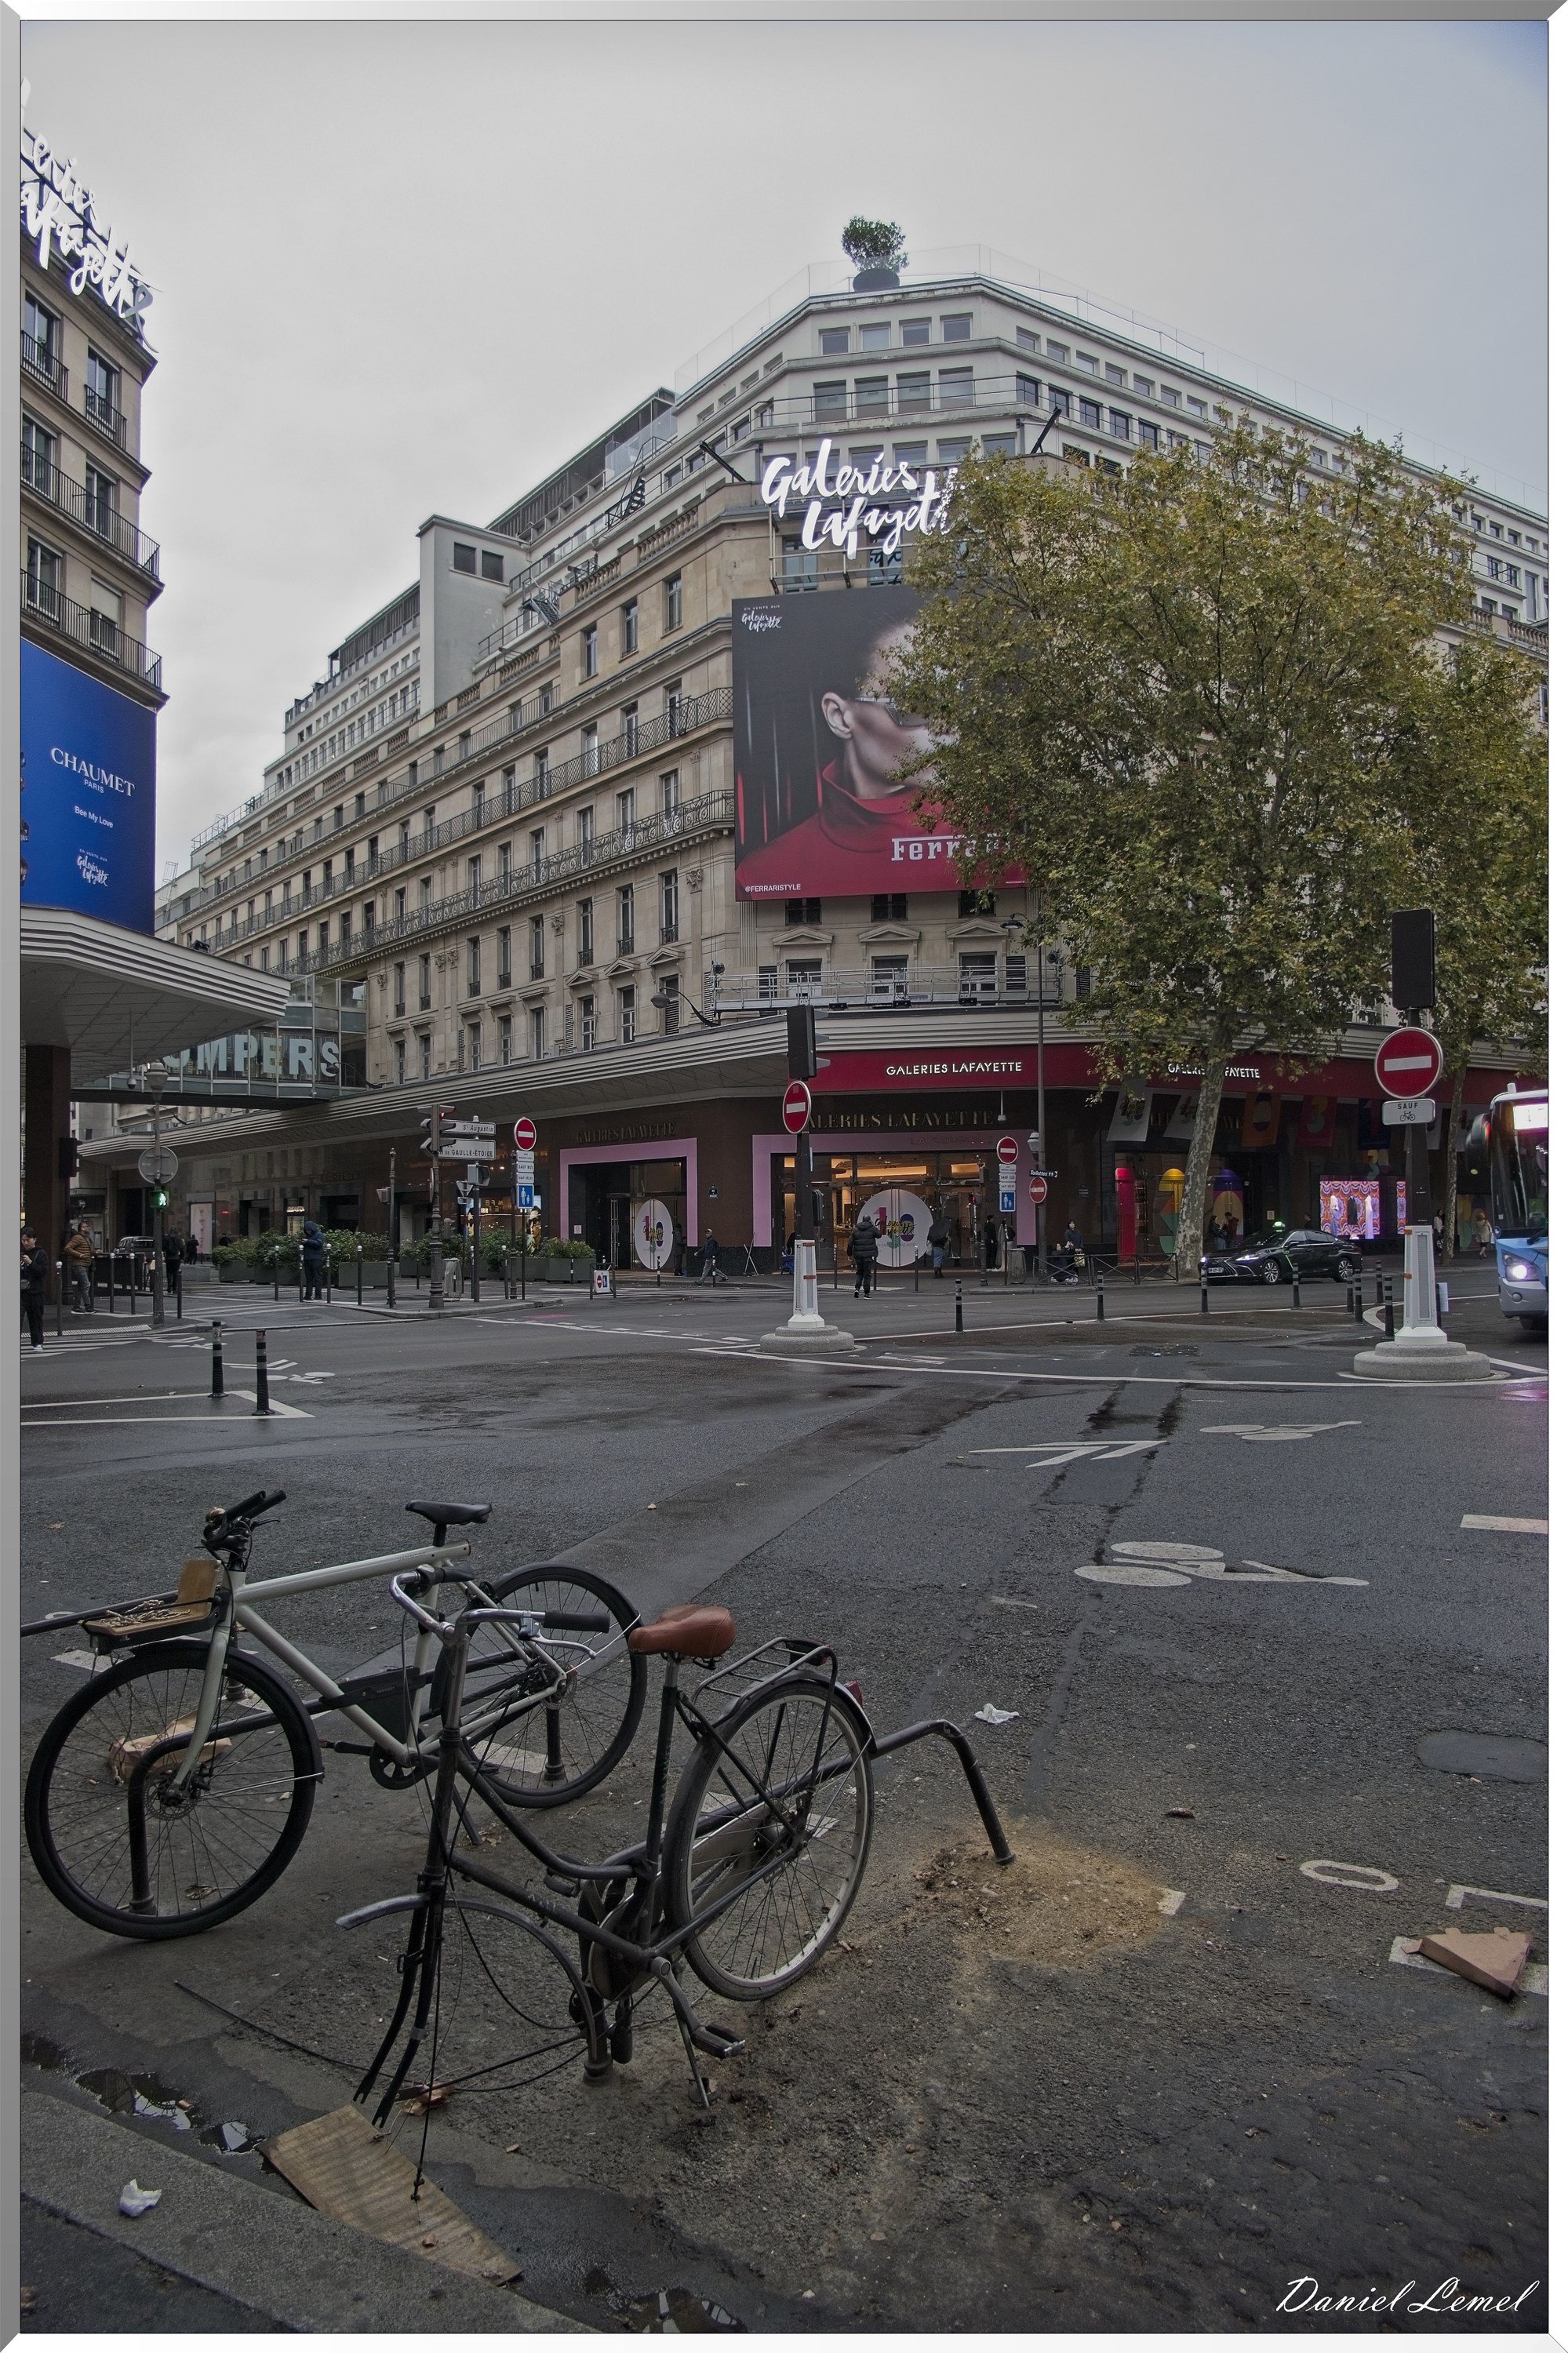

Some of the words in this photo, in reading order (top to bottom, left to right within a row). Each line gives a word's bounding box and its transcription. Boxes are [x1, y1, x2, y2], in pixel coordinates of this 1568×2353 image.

[761, 438, 919, 518] Galeries
[802, 467, 966, 560] Lafayett
[51, 747, 135, 797] CHAUMET
[84, 779, 104, 794] PARIS
[75, 806, 88, 817] Bee
[89, 812, 98, 824] My
[99, 816, 114, 828] Love
[744, 883, 802, 893] @FERRARISTYLE
[886, 1064, 948, 1075] GALERIES
[952, 1062, 1022, 1073] LAFAYETTE
[1224, 1067, 1261, 1078] FAYETTE
[808, 1113, 881, 1129] ALERIES
[888, 1111, 994, 1127] LAFAYETTE
[576, 1129, 620, 1144] GALERIES
[620, 1122, 676, 1140] LAFAYETTE
